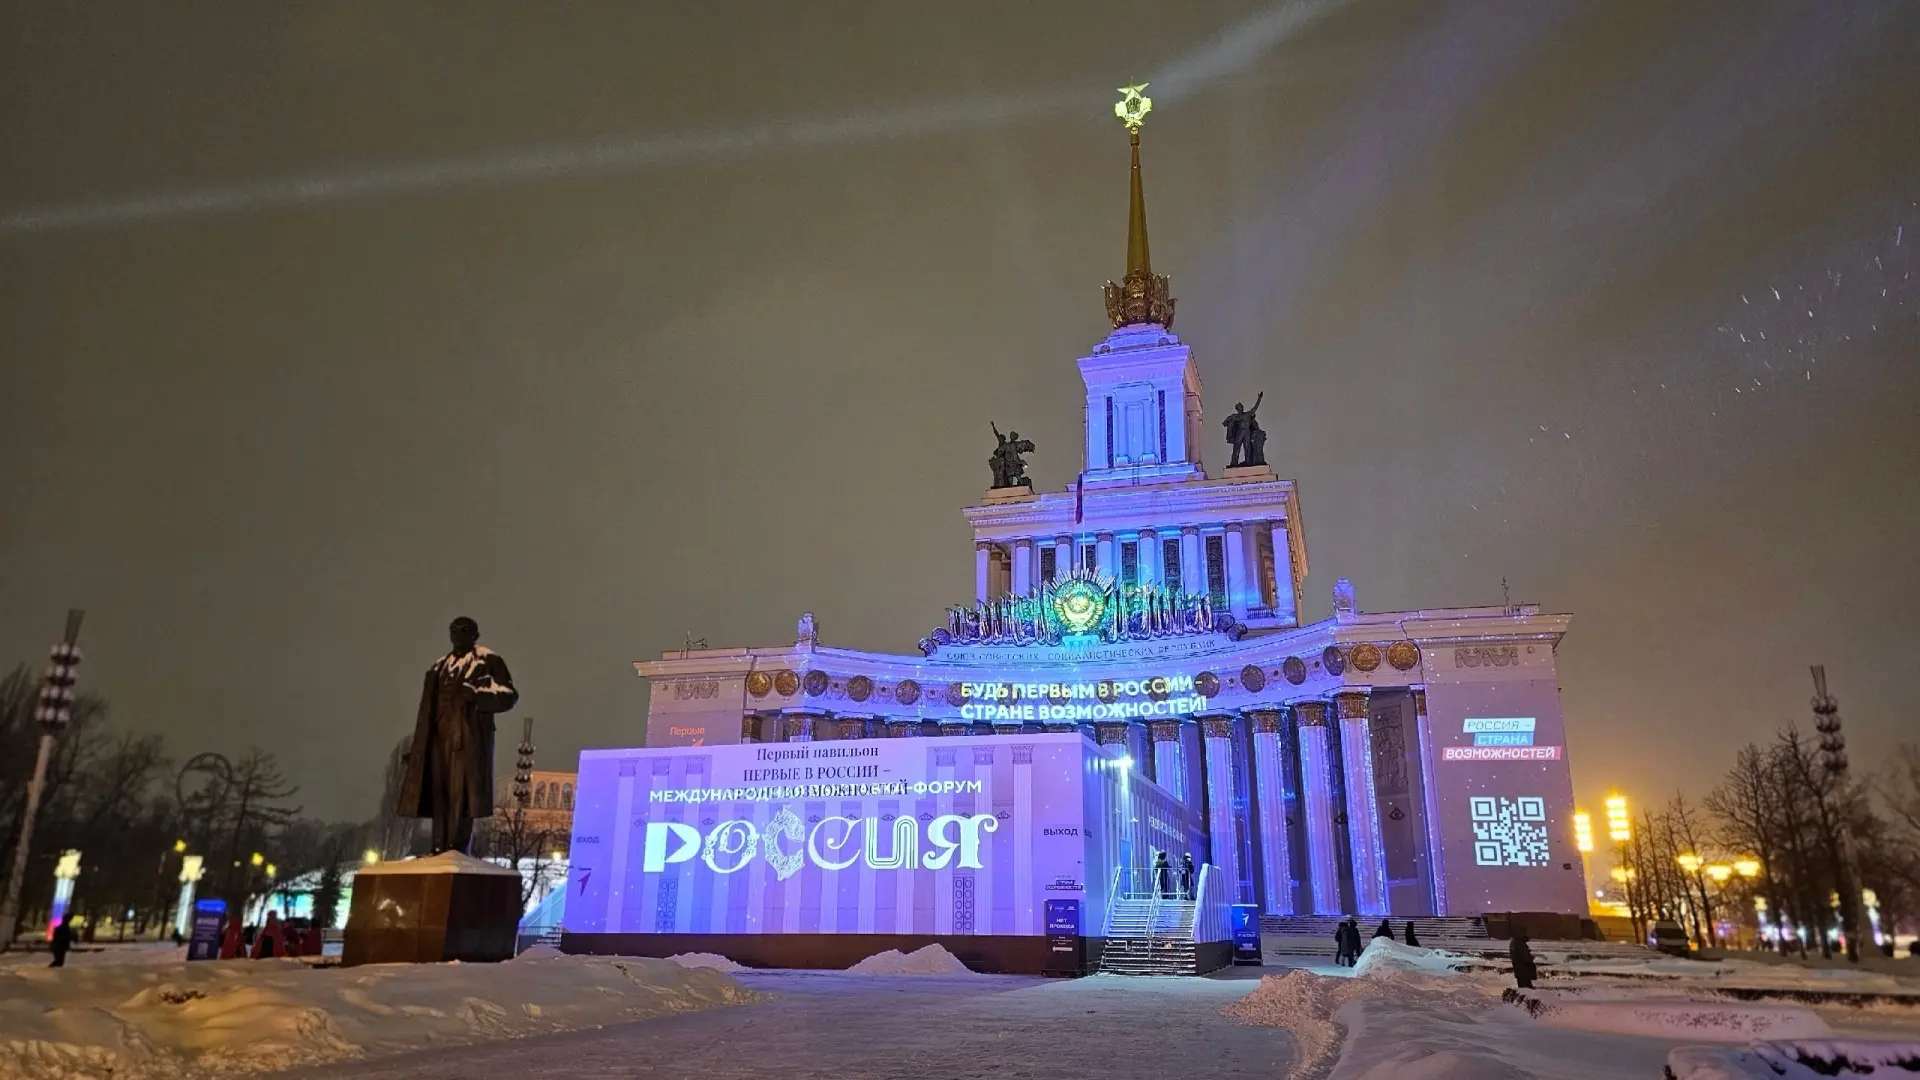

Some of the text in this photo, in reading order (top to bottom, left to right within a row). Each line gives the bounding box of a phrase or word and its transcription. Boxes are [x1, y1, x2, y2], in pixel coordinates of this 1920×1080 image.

[1047, 647, 1154, 661] СОЦИАЛИСТИЧЕСКИХ
[960, 682, 1009, 701] БУДЬ
[1012, 680, 1095, 700] ПЕРВЫМ
[1097, 682, 1109, 698] В
[1112, 674, 1193, 697] РОССИИ
[960, 694, 1208, 720] СТРАНЕ ВОЗМОЖНОСТЕЙ!
[669, 726, 706, 738] Первые
[1467, 720, 1520, 731] РОССИЯ
[1477, 734, 1529, 745] СТРАНА
[756, 746, 879, 763] Первый павильон
[1445, 746, 1556, 760] ВОЗМОЖНОСТЕЙ
[743, 767, 801, 782] ПЕРВЫЕ
[804, 766, 815, 780] В
[817, 764, 879, 780] РОССИИ
[649, 783, 808, 803] МЕЖДУНАРОДН
[1043, 828, 1079, 837] ВЫХОД
[642, 804, 998, 881] РОССИЯ
